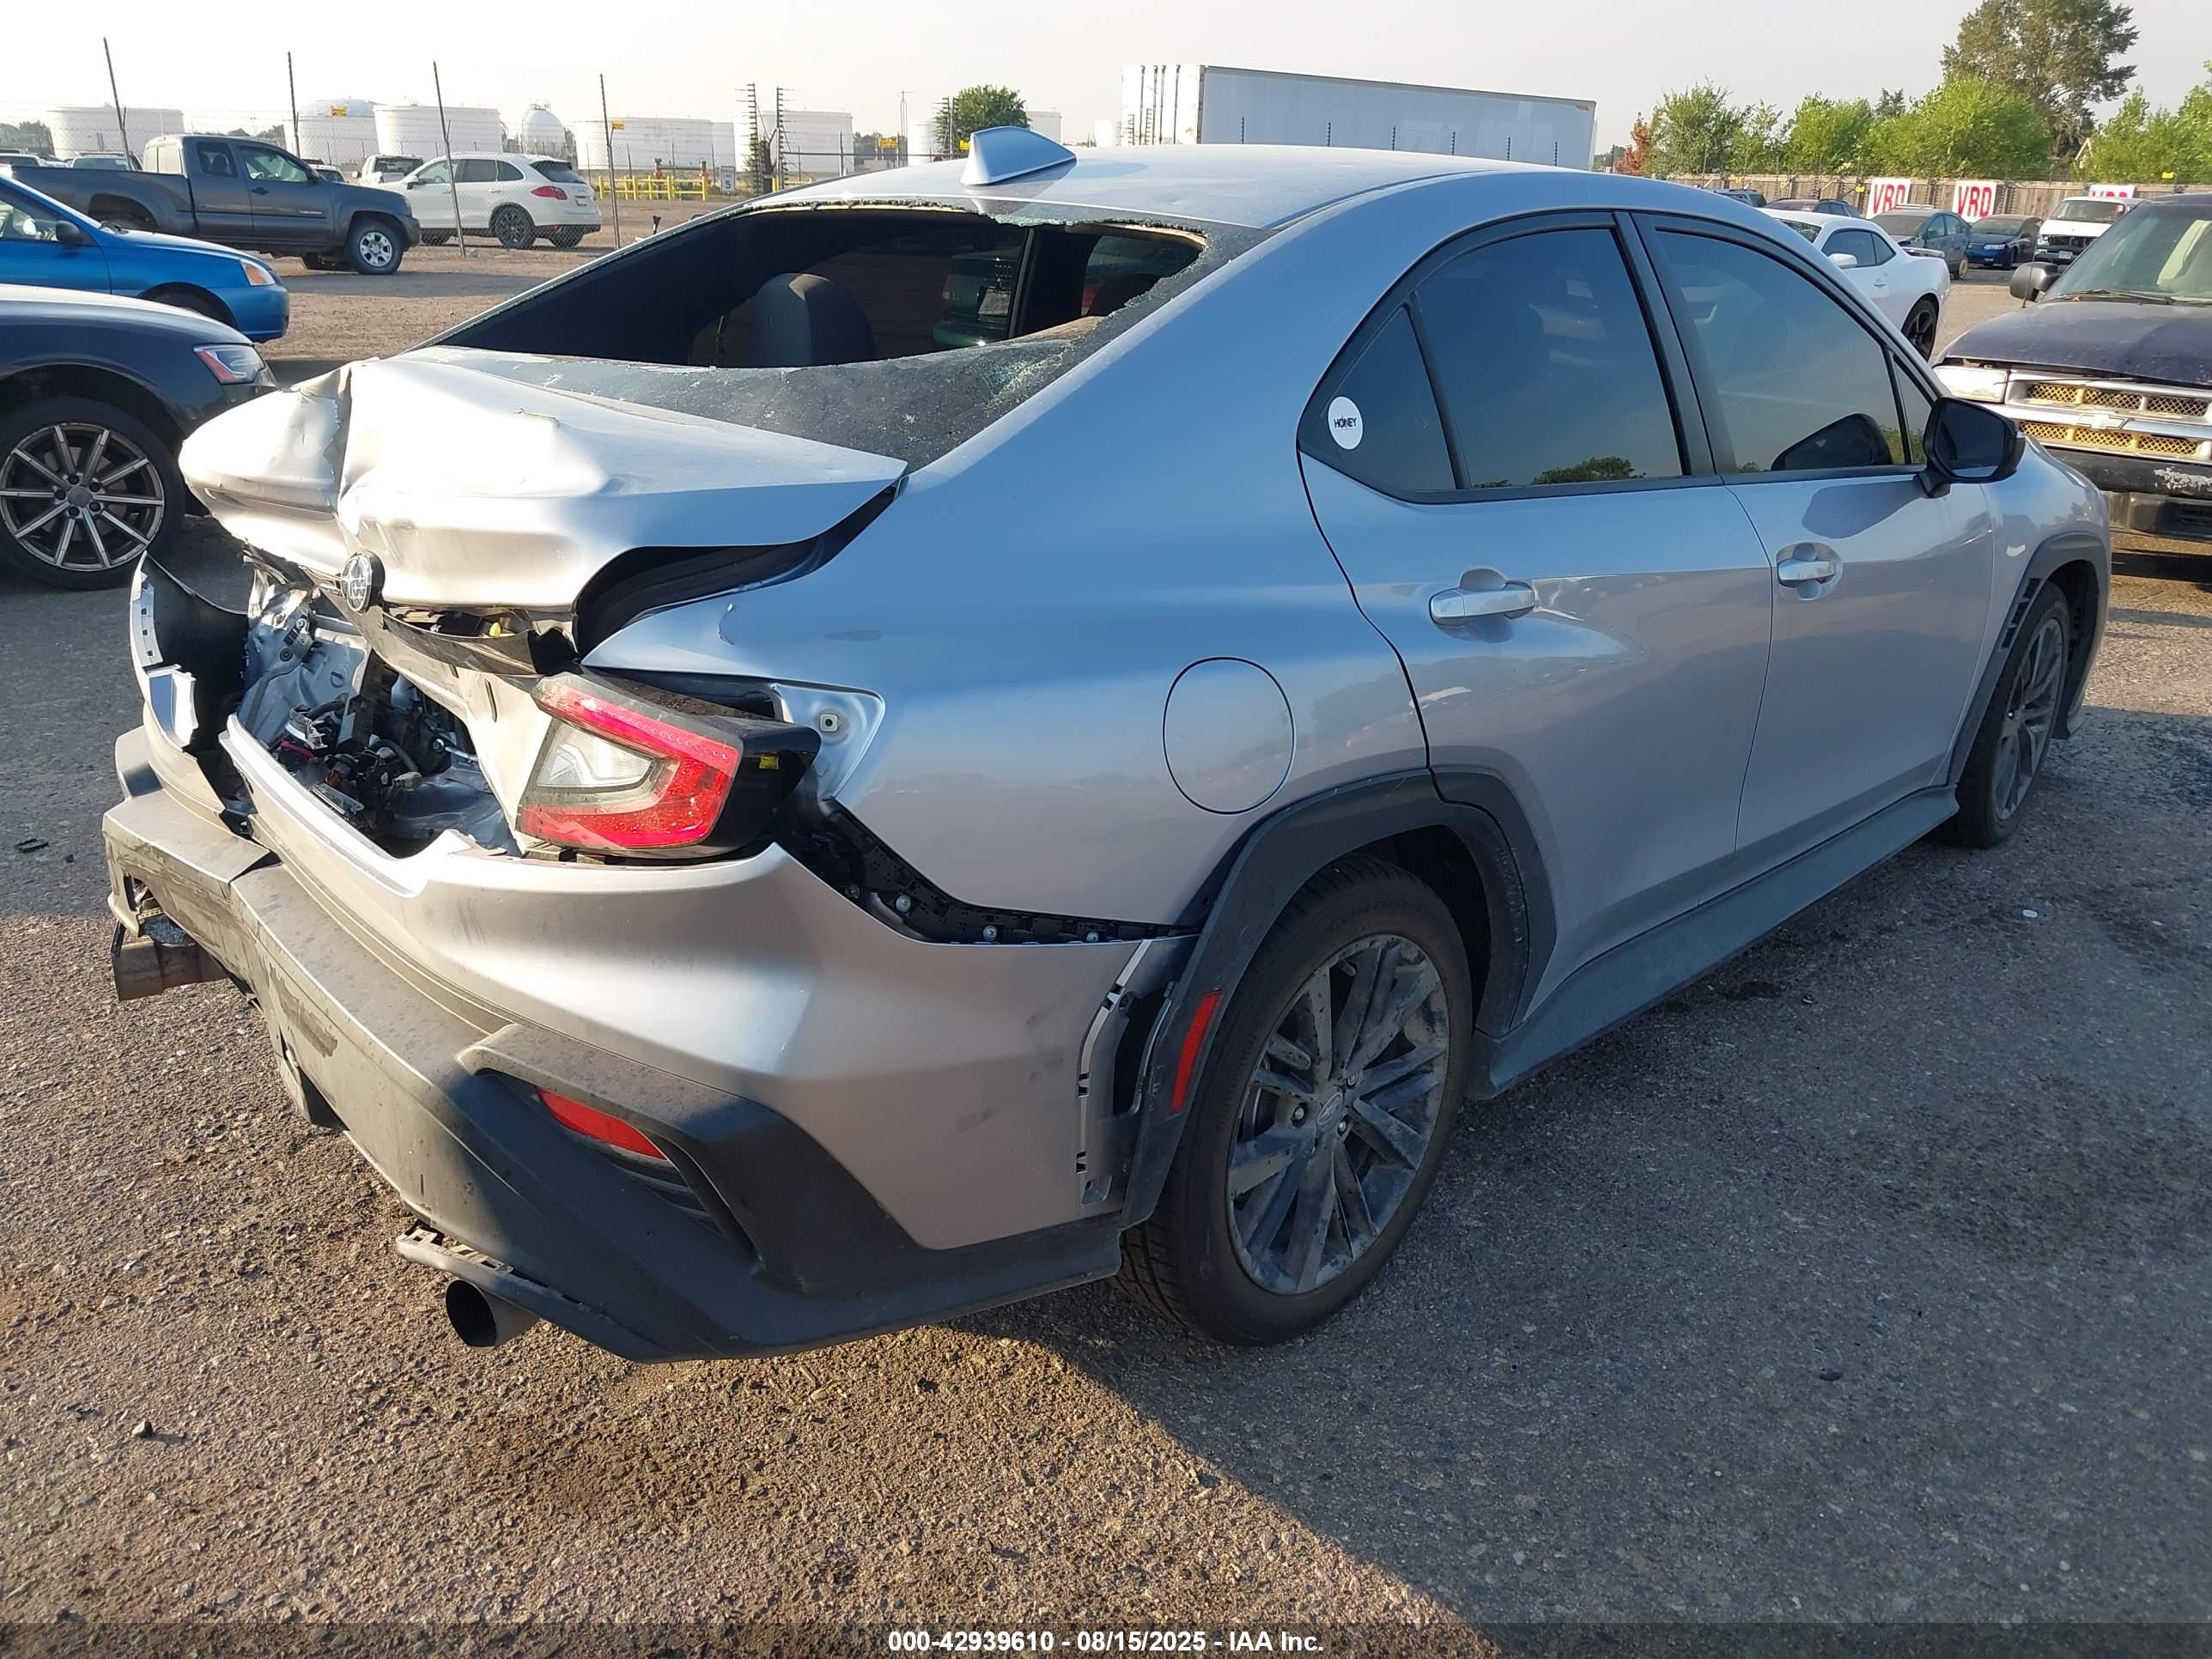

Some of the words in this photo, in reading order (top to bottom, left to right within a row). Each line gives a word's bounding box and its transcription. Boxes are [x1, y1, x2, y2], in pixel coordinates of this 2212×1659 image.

[726, 180, 732, 189] 5
[1958, 185, 1992, 217] VRD
[1334, 417, 1357, 428] HONEY
